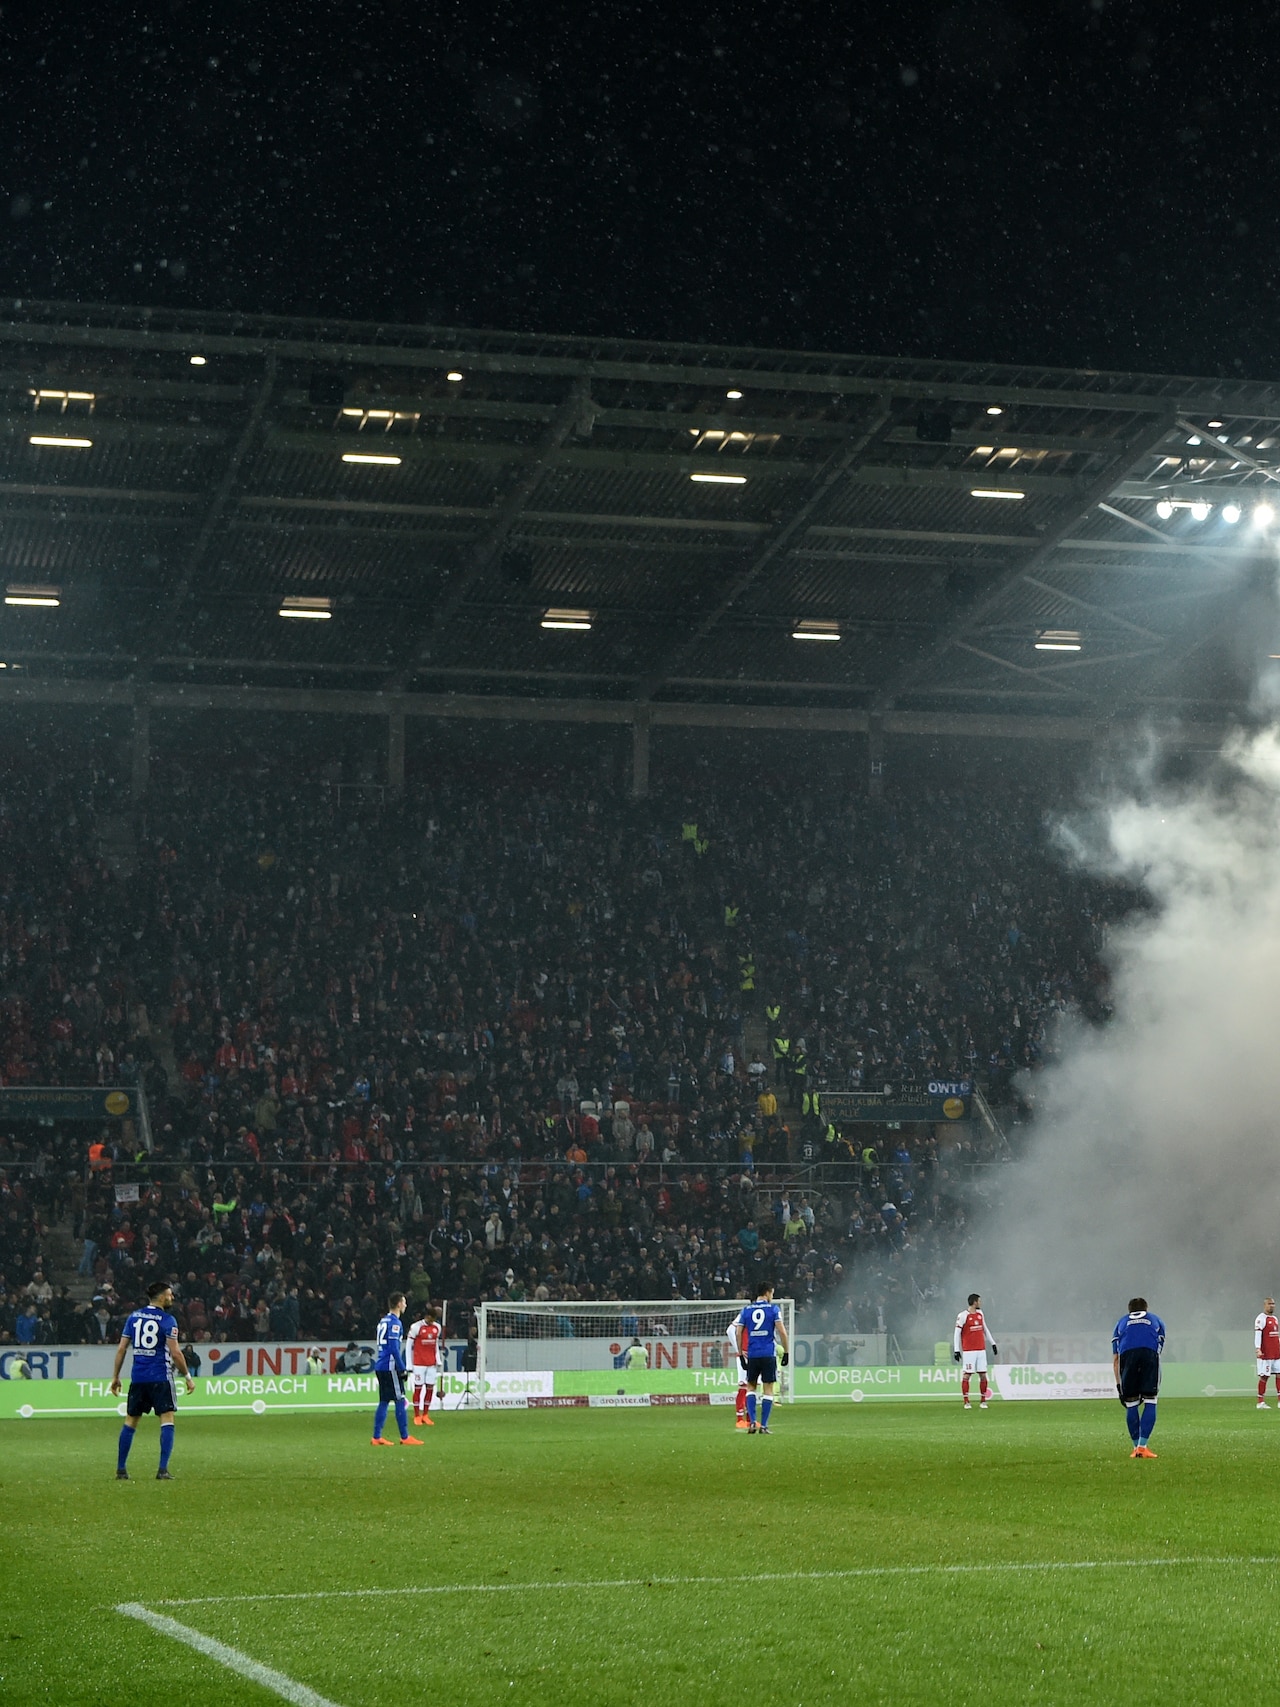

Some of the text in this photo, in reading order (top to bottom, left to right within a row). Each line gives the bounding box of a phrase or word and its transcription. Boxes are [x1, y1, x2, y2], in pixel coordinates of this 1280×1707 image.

[928, 1083, 958, 1093] OWT
[752, 1309, 765, 1330] 9
[133, 1318, 159, 1349] 18
[809, 1369, 900, 1384] MORBACH
[1008, 1367, 1114, 1385] flibco.com
[206, 1379, 307, 1395] MORBACH
